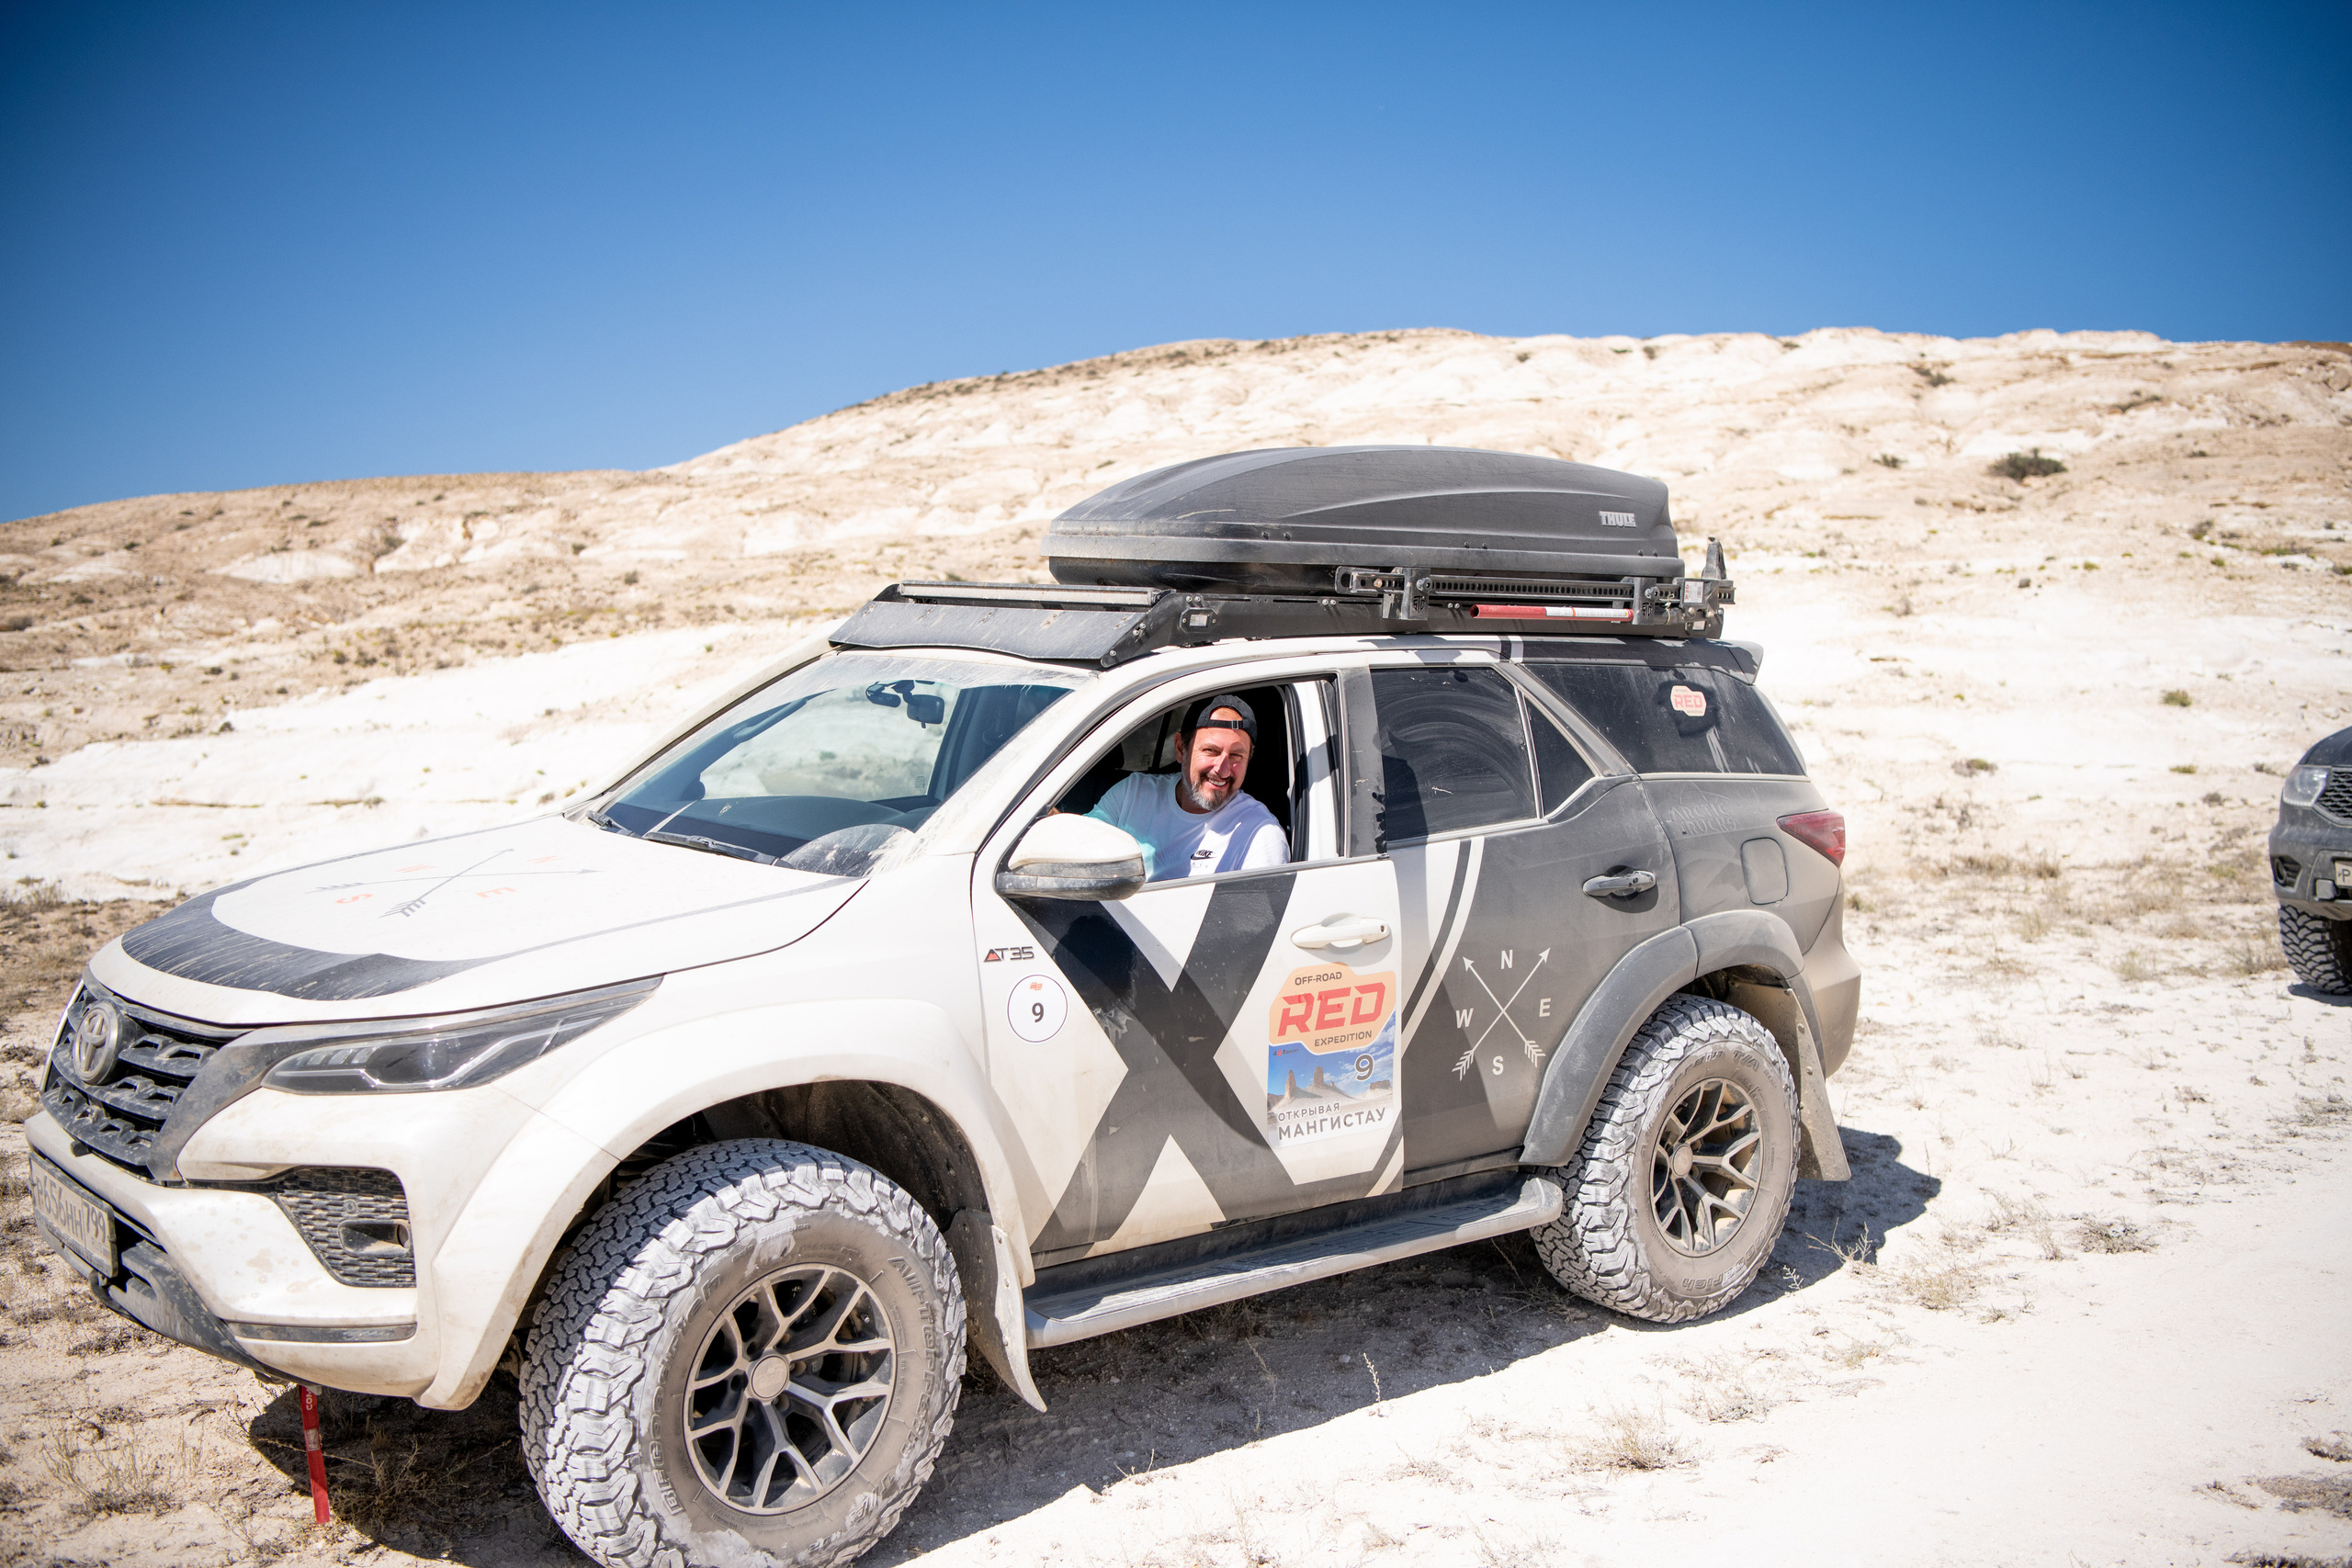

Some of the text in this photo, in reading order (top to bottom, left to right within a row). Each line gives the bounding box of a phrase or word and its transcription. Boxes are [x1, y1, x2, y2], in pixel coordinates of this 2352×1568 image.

[1599, 511, 1636, 527] THULE
[1673, 694, 1703, 708] RED
[1670, 803, 1730, 820] ARCTIC
[1679, 817, 1737, 836] TRUCKS
[1196, 849, 1214, 858] NIKE
[1500, 949, 1513, 970] N
[1295, 971, 1342, 986] OFF-ROAD
[1032, 1002, 1045, 1023] 9
[1277, 982, 1386, 1037] RED
[1539, 998, 1551, 1017] E
[1455, 1008, 1474, 1029] W
[1314, 1031, 1373, 1047] EXPEDITION
[1354, 1054, 1374, 1081] 9
[1492, 1055, 1504, 1076] S
[1278, 1102, 1340, 1122] ОТКРЫВАЯ
[1278, 1108, 1385, 1140] МАНГИСТАУ
[84, 1201, 107, 1244] 799
[887, 1257, 937, 1459] All-Terrain
[649, 1273, 723, 1517] BFGoodrich
